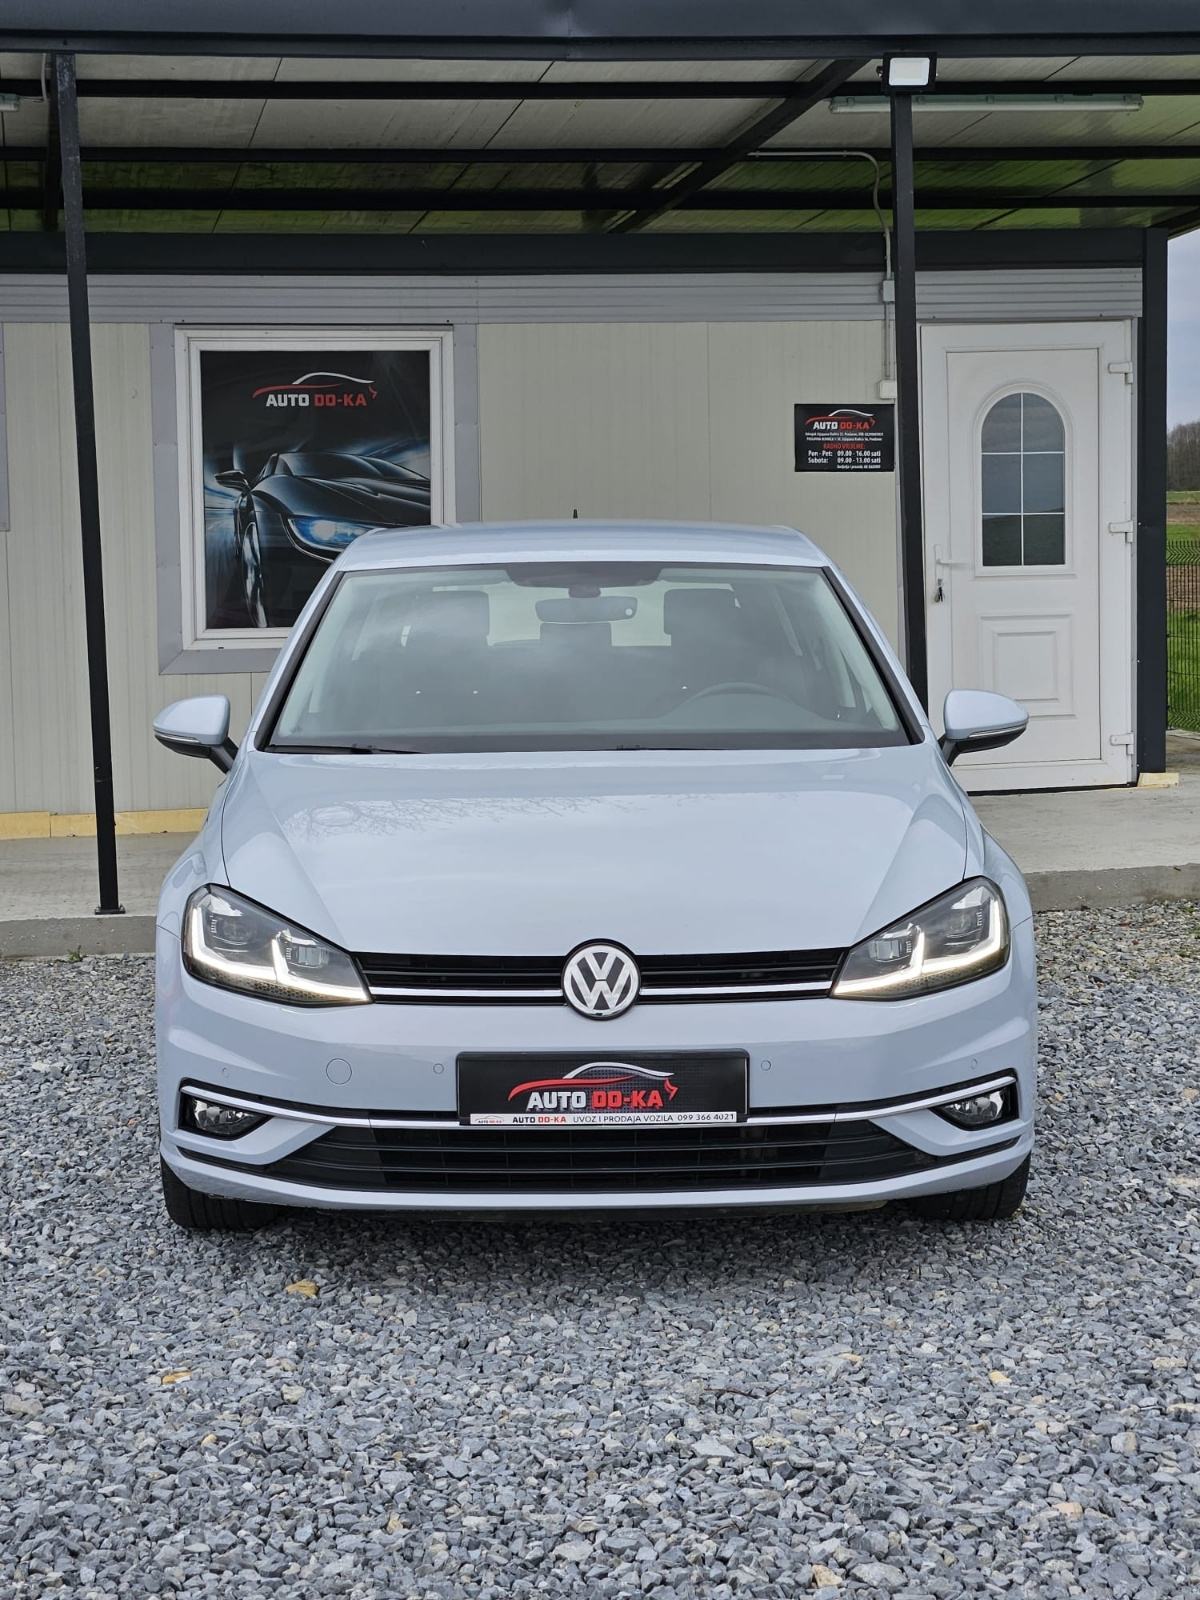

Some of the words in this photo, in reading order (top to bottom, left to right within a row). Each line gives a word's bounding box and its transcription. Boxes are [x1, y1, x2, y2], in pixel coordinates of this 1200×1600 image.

[266, 394, 309, 407] AUTO
[314, 393, 367, 407] DO-KA
[813, 421, 838, 430] AUTO
[566, 948, 636, 1013] VW
[527, 1091, 586, 1109] AUTO
[592, 1090, 664, 1109] DO-KA
[604, 1115, 641, 1123] PRODAJA
[644, 1114, 674, 1122] VOZILA
[678, 1113, 693, 1121] 099
[696, 1113, 711, 1121] 366
[713, 1113, 734, 1121] 4021
